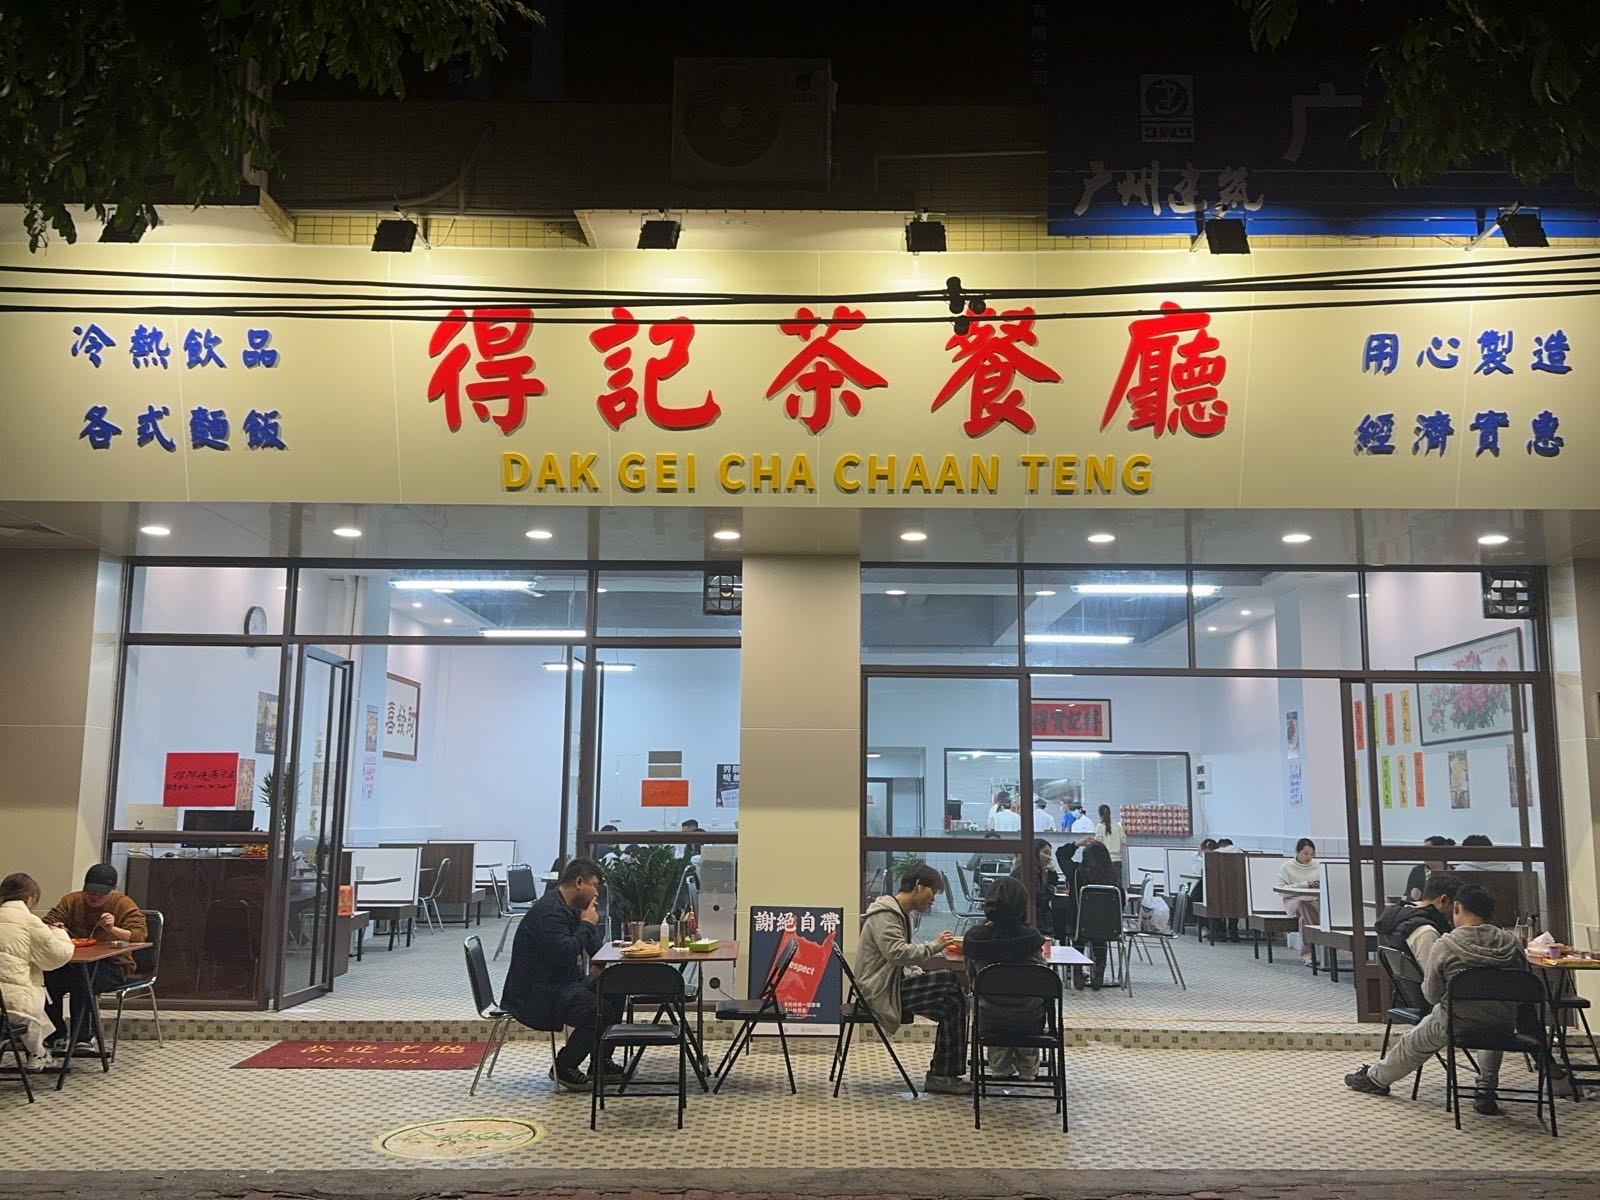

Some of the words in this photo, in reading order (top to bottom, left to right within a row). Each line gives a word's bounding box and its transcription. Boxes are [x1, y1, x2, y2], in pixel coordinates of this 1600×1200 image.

[71, 324, 280, 369] 冷熱飲品
[1363, 330, 1572, 375] 用心製造
[427, 302, 1229, 437] 得記茶餐廳
[80, 406, 287, 451] 各式麵飯
[1354, 411, 1564, 457] 經濟實惠
[503, 453, 598, 492] DAK
[618, 453, 697, 492] GEI
[719, 454, 815, 493] CHA
[834, 454, 1000, 494] CHAAN
[1021, 454, 1153, 493] TENG
[753, 910, 841, 934] 謝絕自帶
[788, 960, 815, 976] espect
